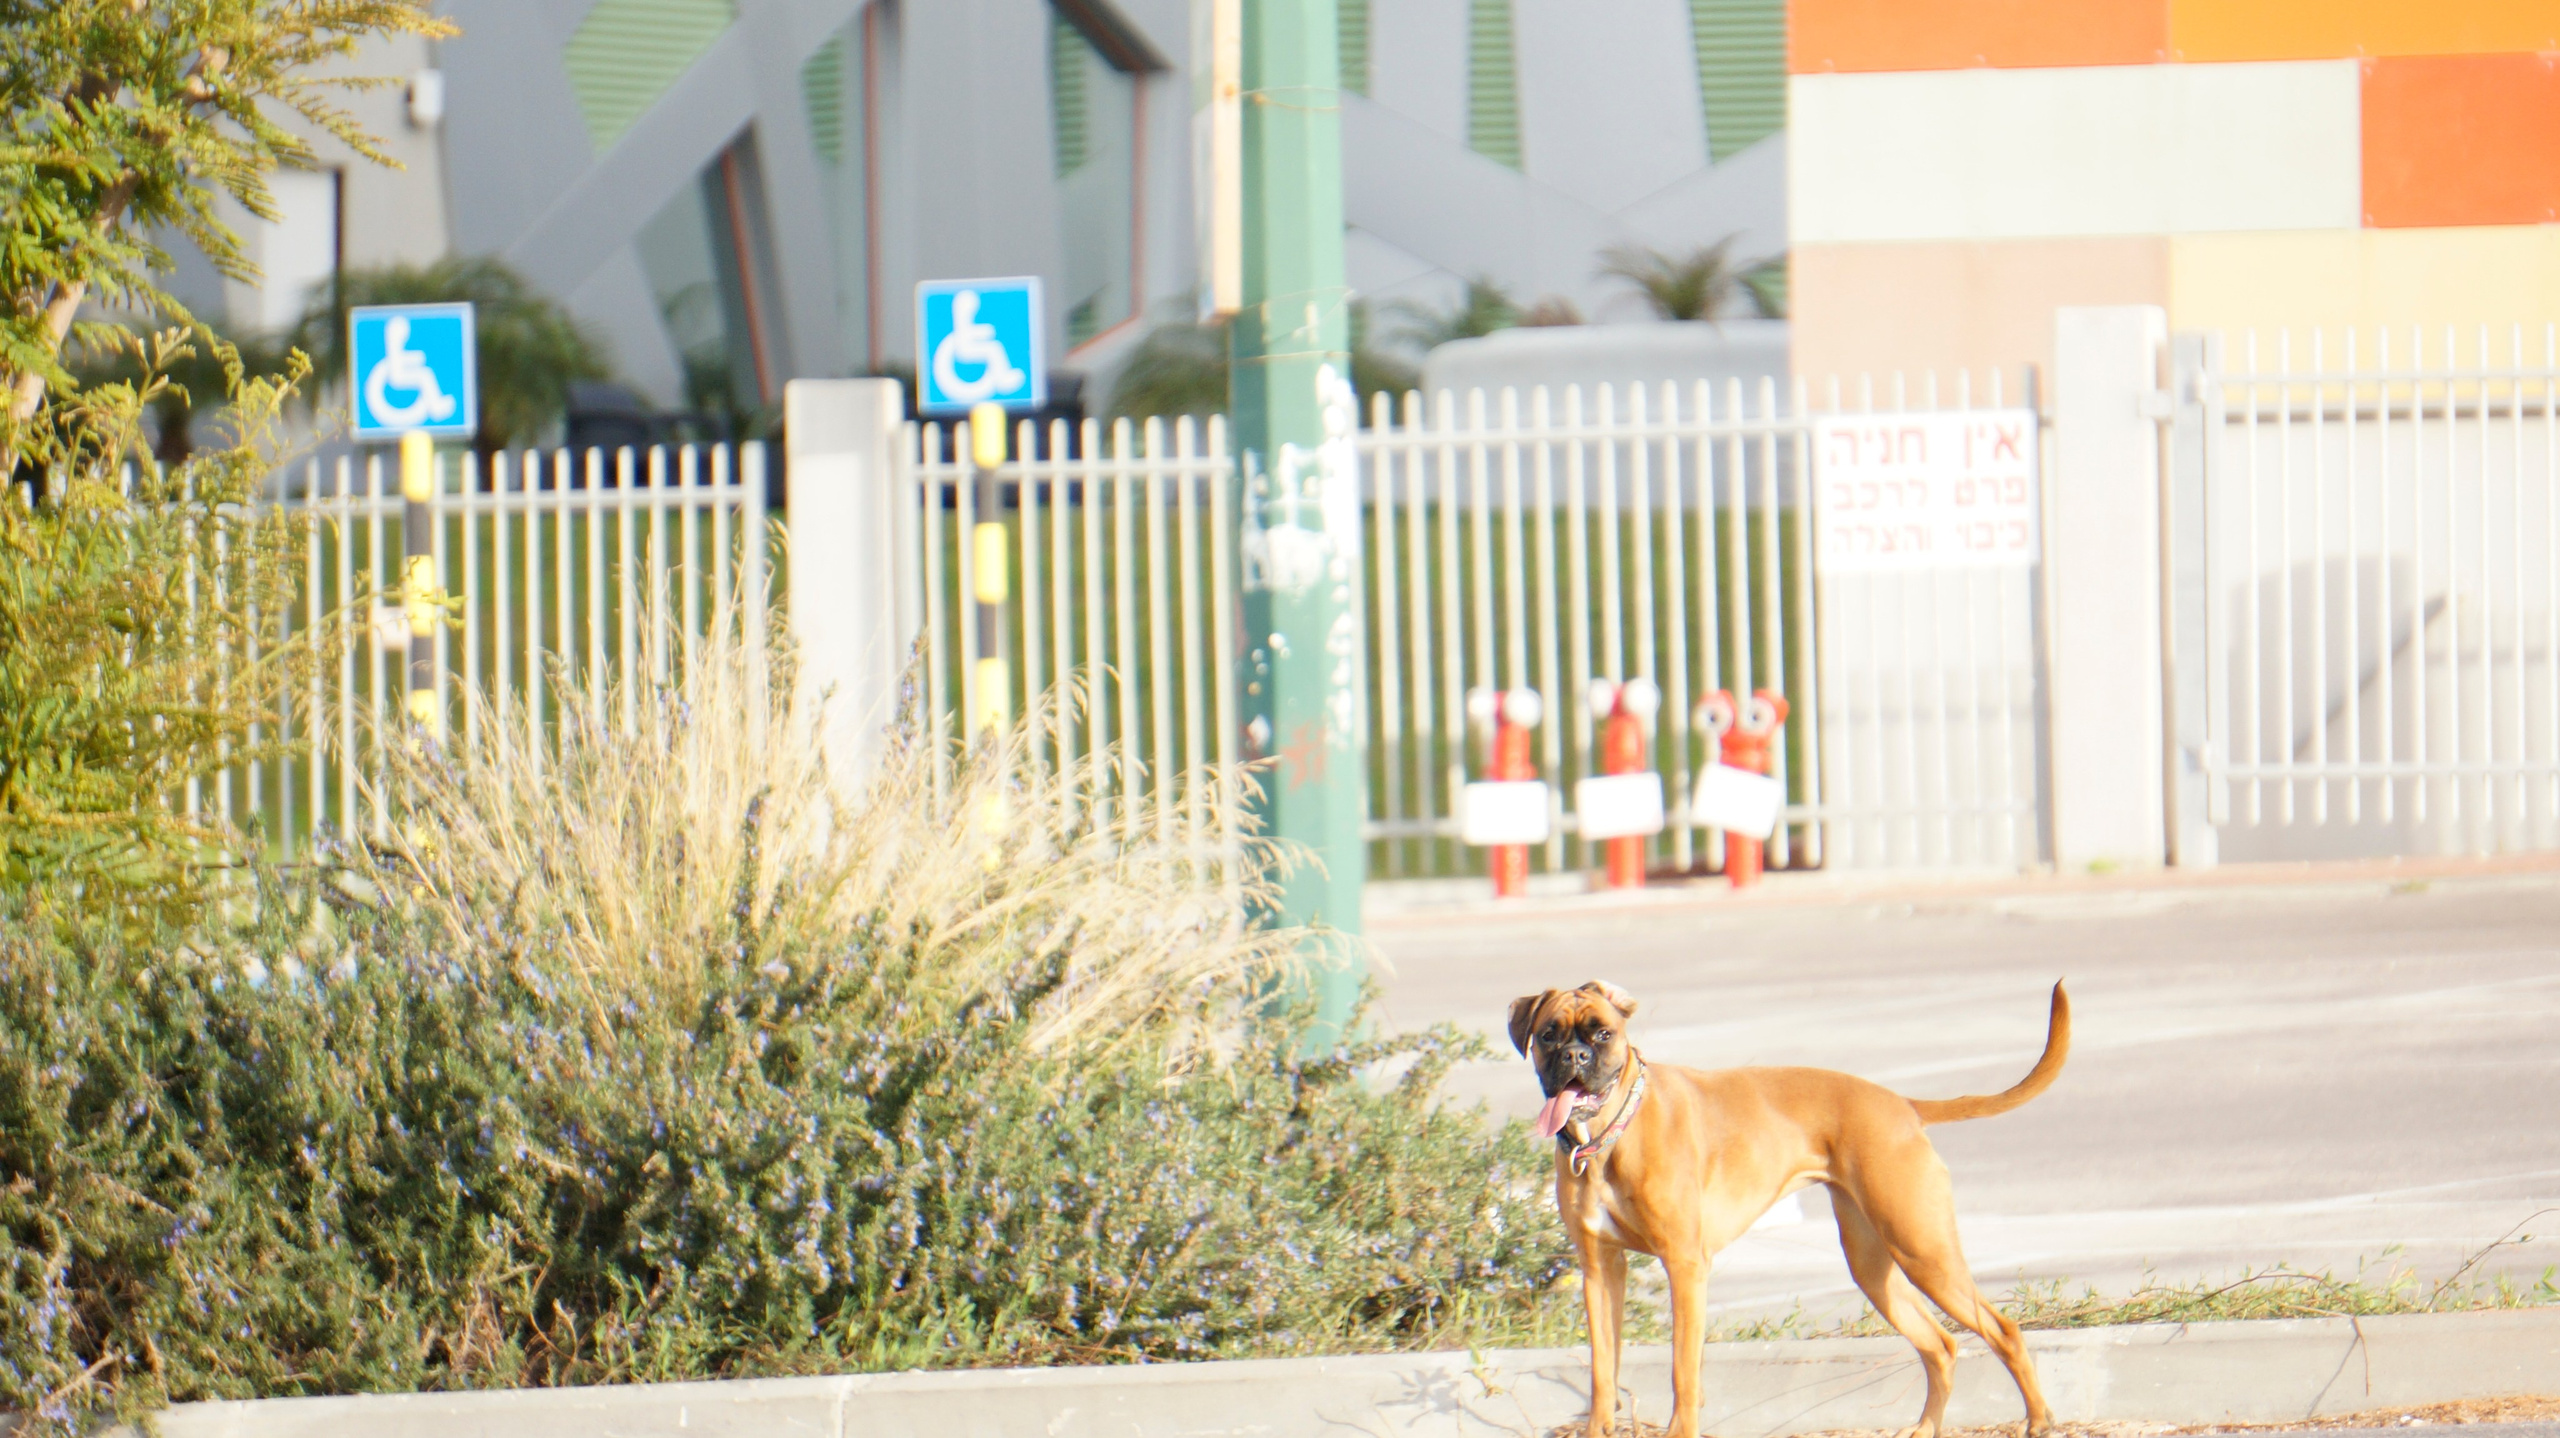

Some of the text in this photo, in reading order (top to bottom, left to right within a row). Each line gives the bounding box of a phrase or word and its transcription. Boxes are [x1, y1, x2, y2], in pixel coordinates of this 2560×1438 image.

[1829, 422, 2023, 469] אין חניה
[1832, 476, 2028, 510] פרט לרכב
